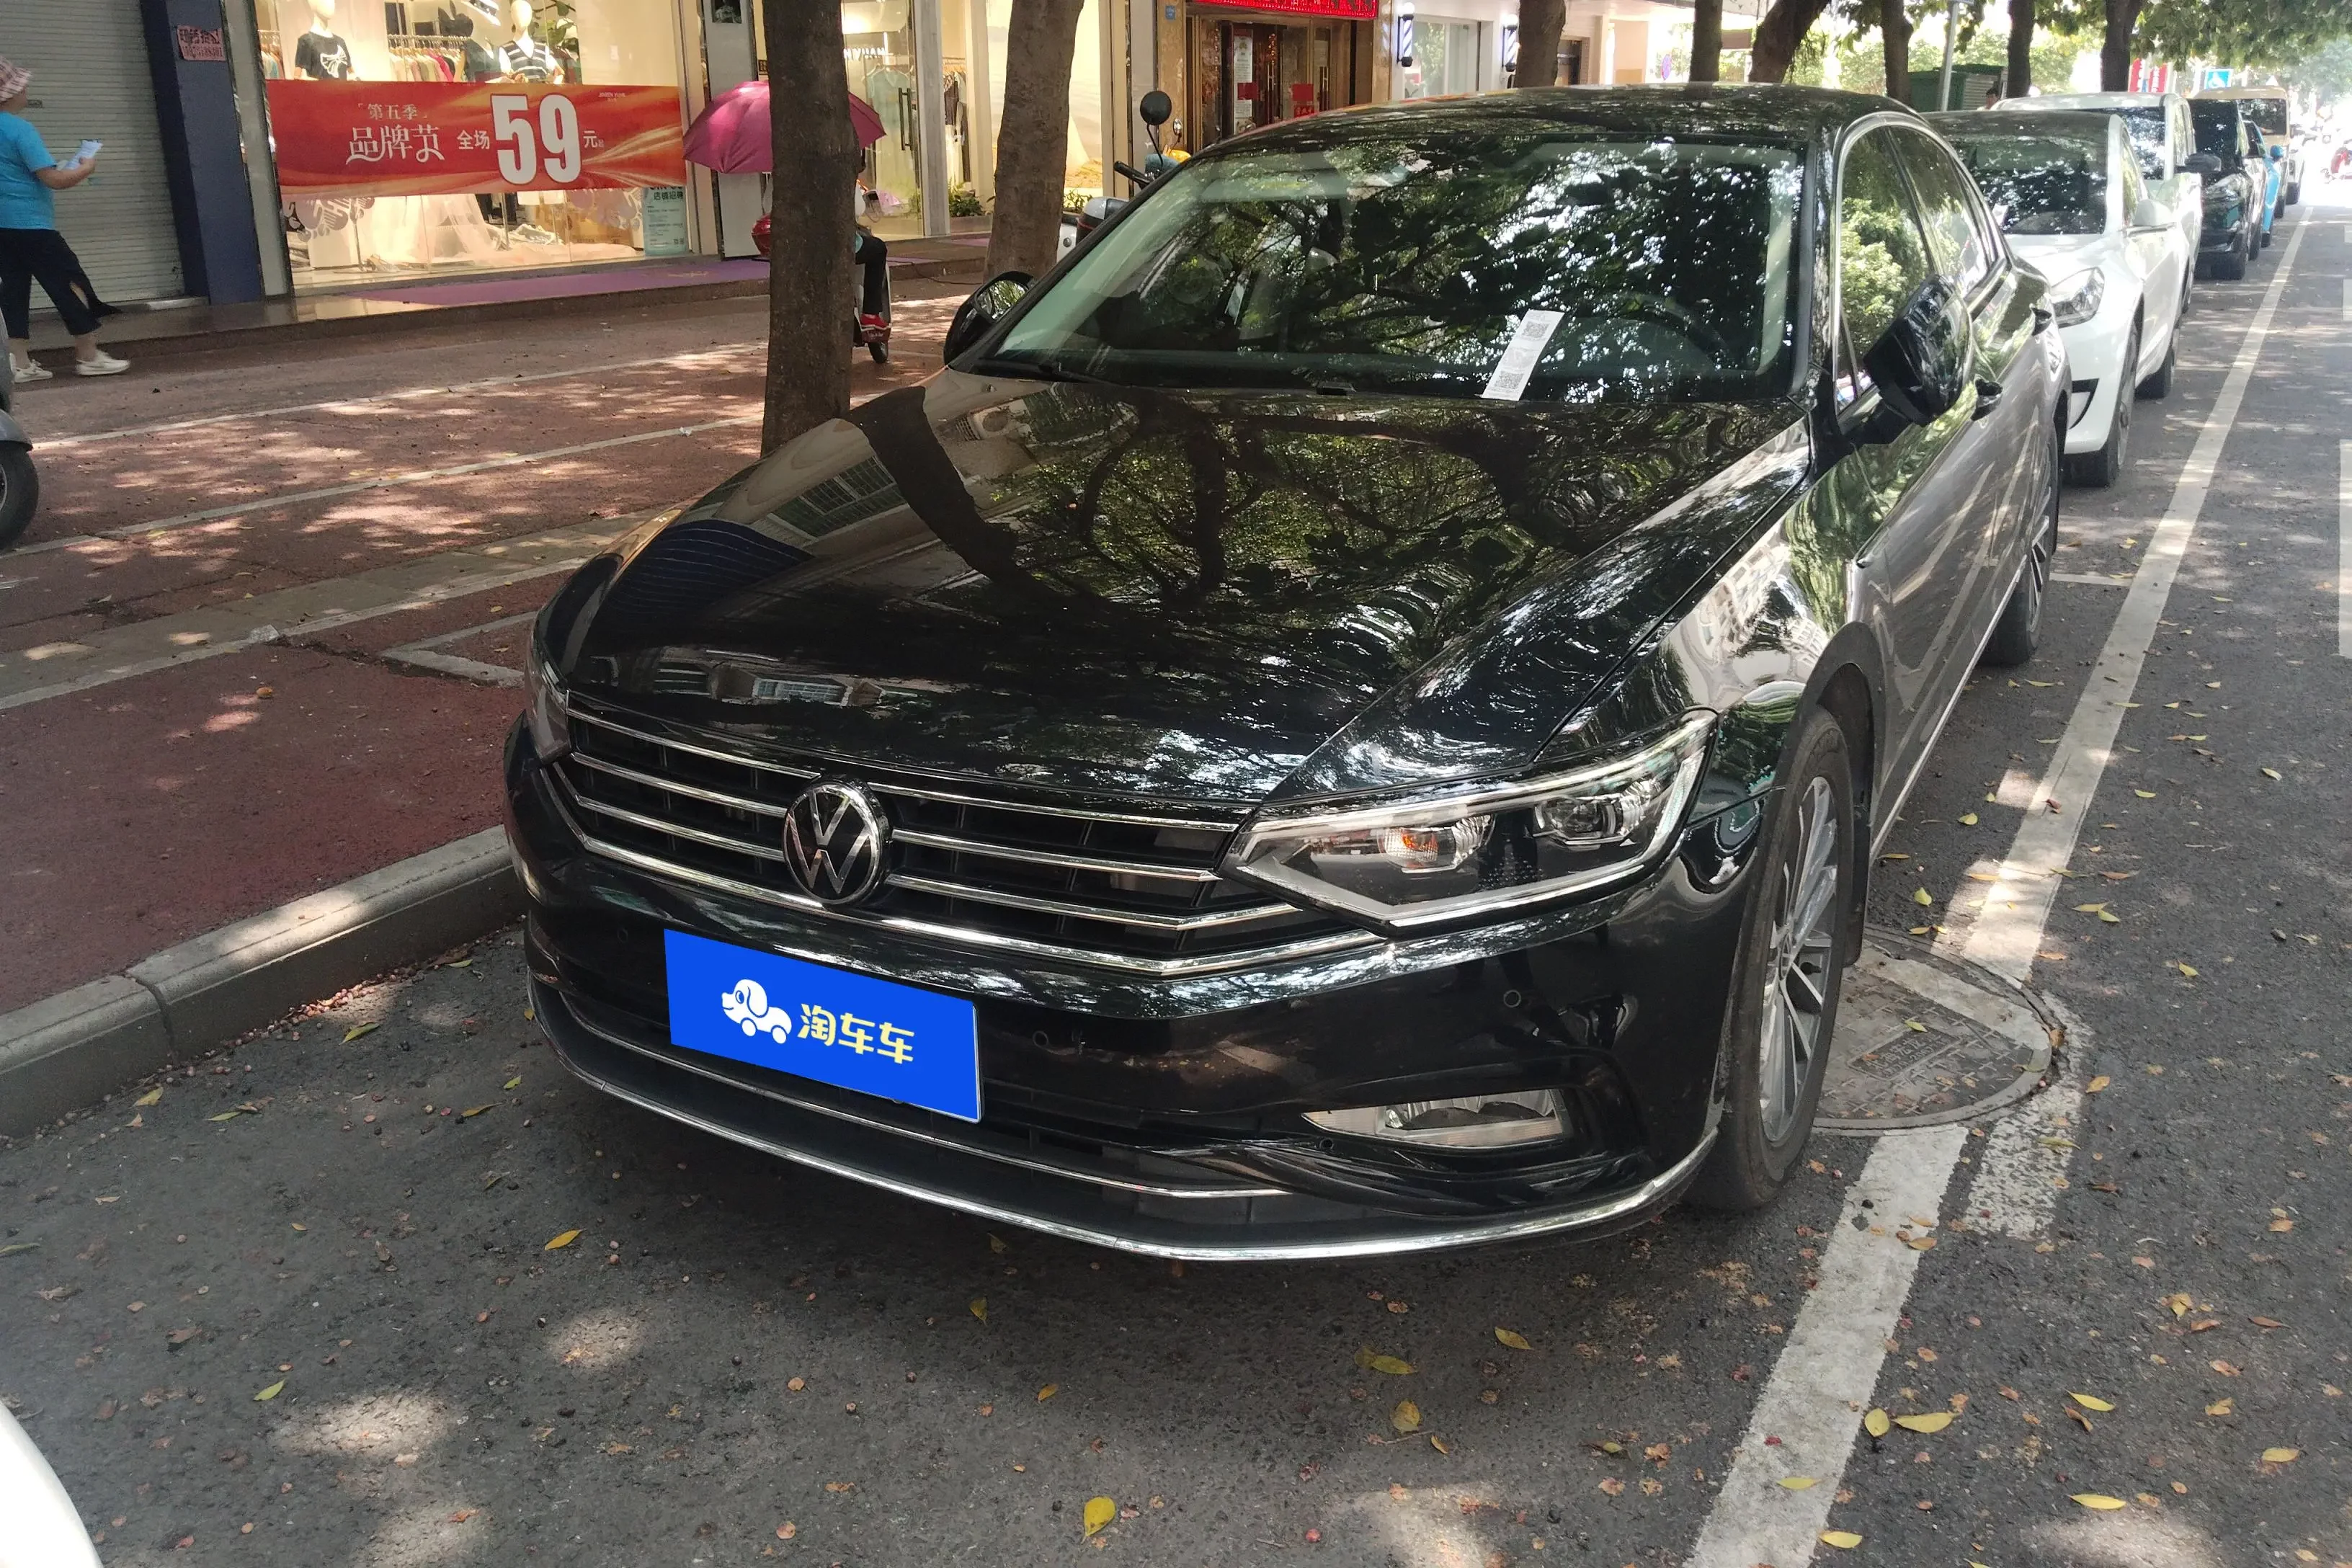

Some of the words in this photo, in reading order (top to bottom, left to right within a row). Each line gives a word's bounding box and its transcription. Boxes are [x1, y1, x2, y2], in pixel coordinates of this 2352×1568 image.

[345, 124, 445, 165] 品牌节
[456, 130, 490, 150] 全场
[491, 94, 582, 184] 59
